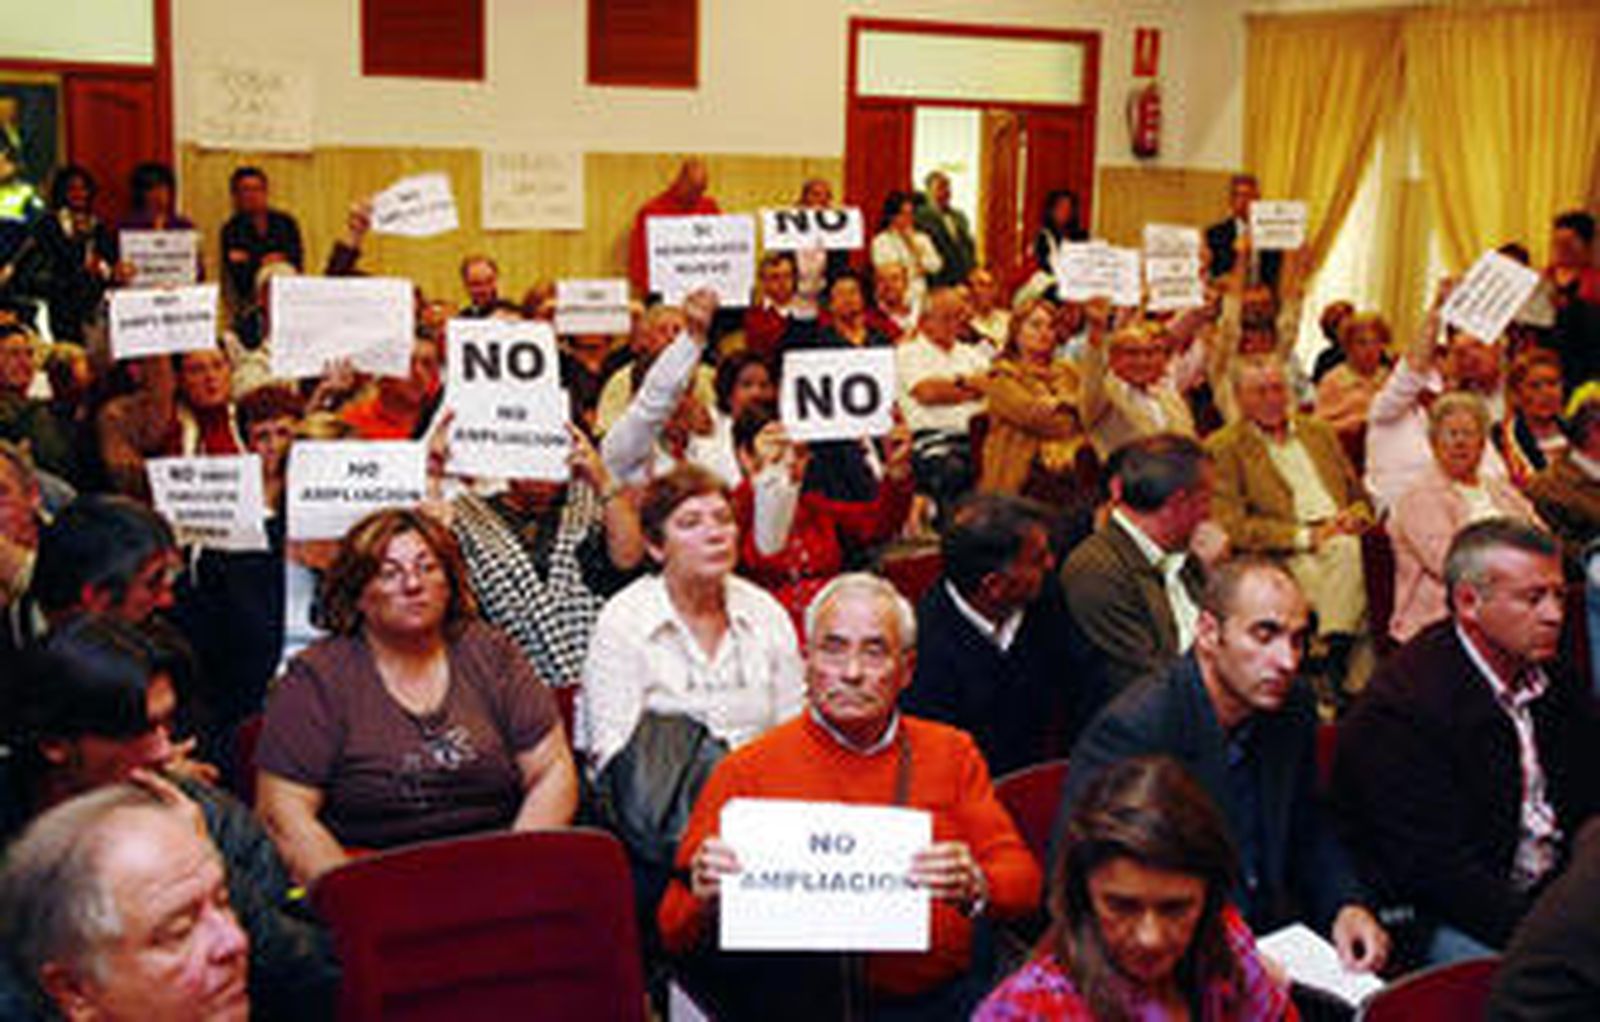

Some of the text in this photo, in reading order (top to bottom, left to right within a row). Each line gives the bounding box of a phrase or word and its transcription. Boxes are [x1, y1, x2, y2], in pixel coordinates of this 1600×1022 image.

[775, 209, 849, 233] NO
[462, 341, 545, 381] NO
[796, 372, 881, 420] NO
[348, 462, 379, 478] NO
[809, 833, 856, 854] NO
